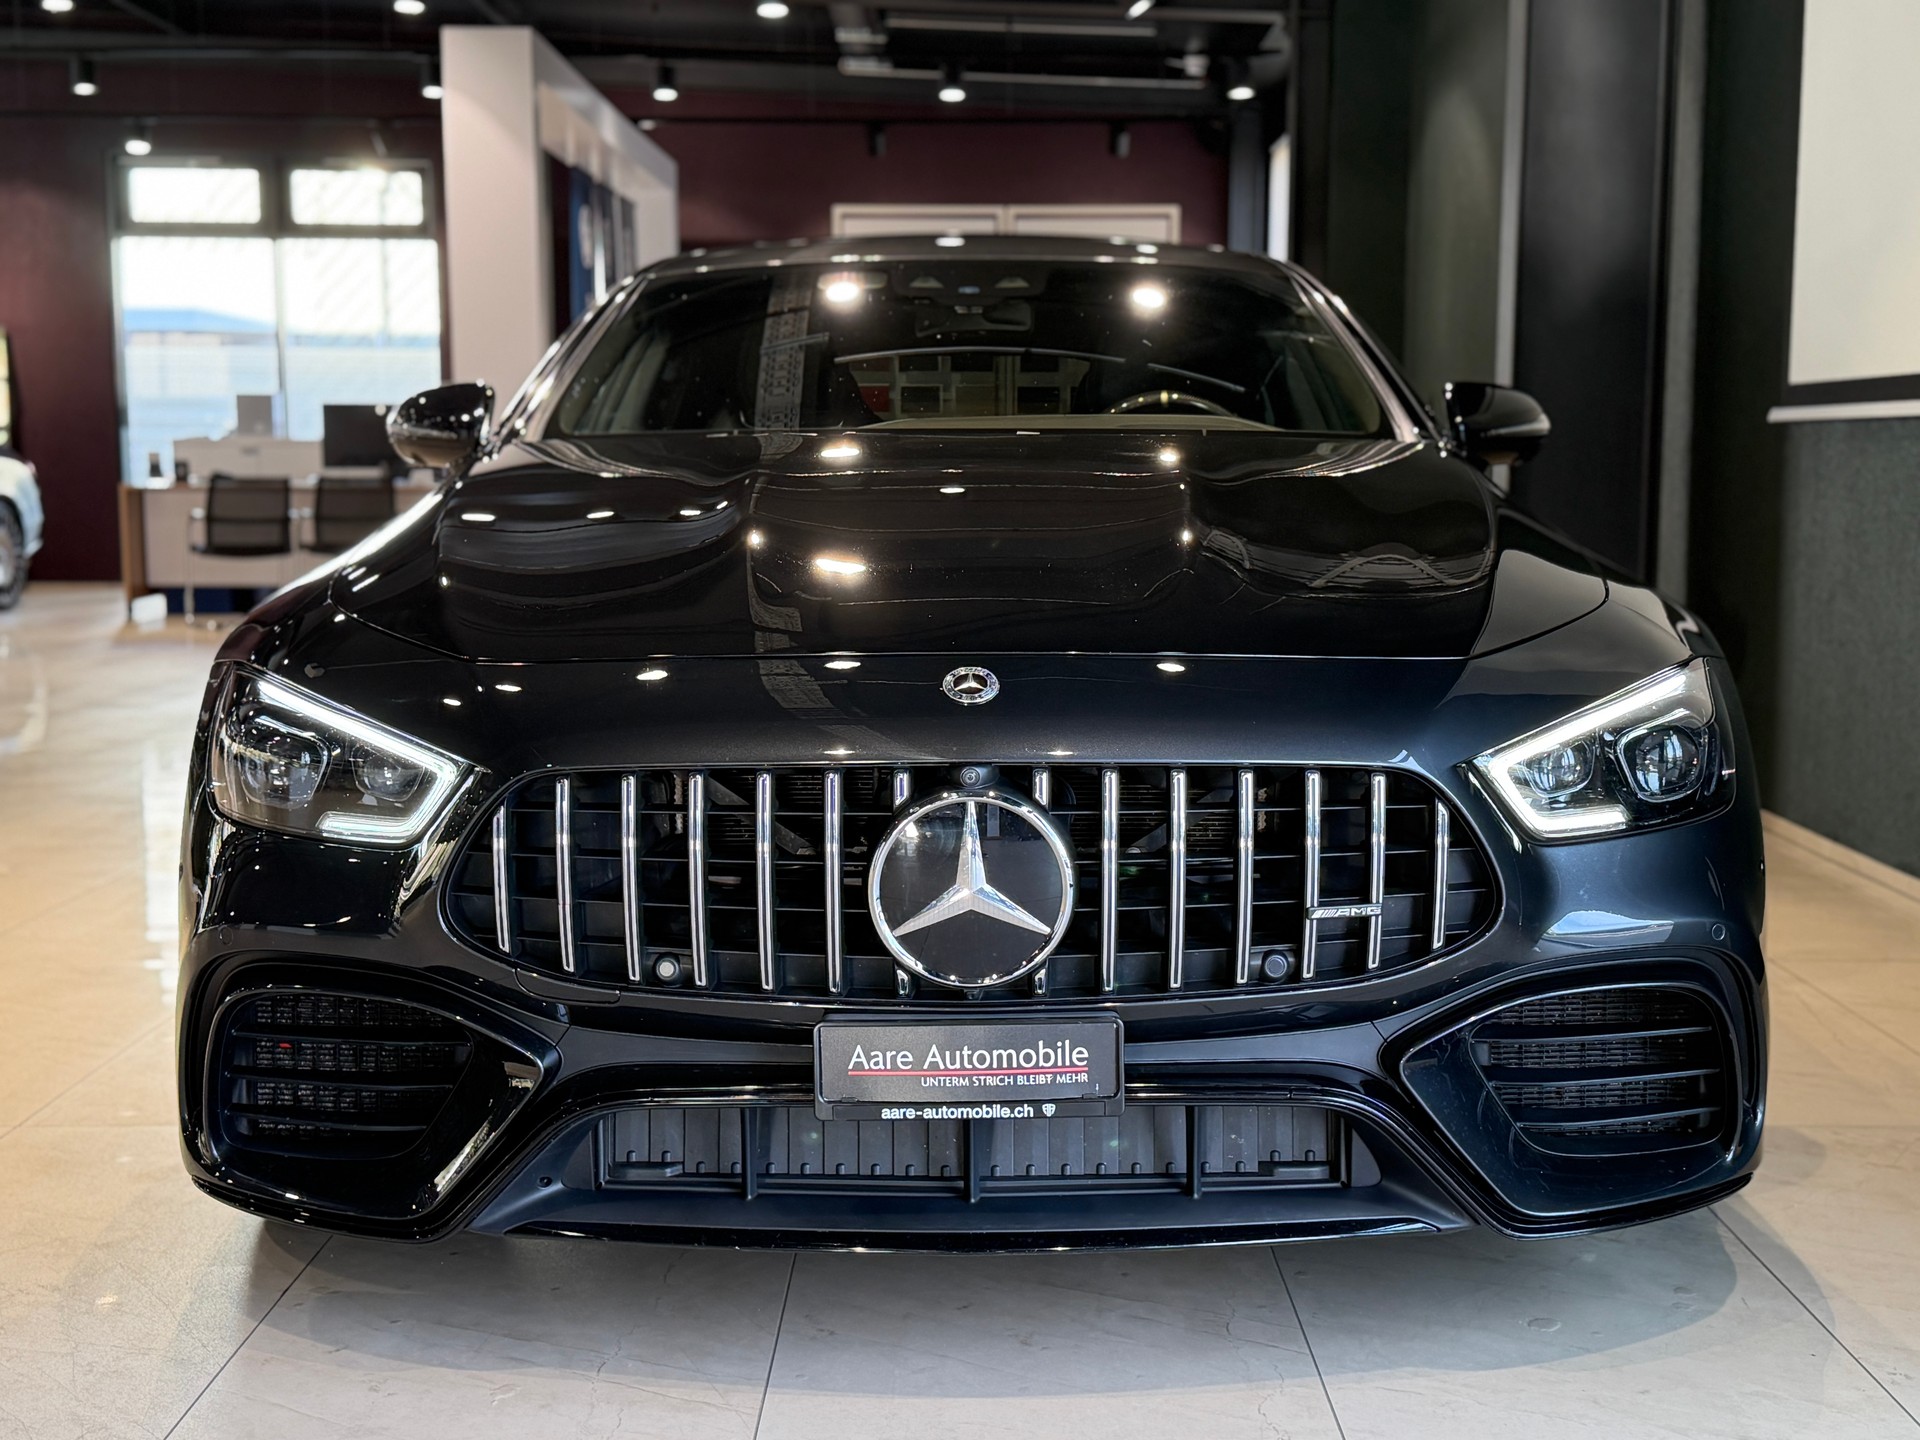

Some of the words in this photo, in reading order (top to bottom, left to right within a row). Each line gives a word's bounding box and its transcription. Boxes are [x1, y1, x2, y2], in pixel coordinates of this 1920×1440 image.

[1333, 907, 1382, 917] AMG
[848, 1044, 913, 1070] Aare
[923, 1040, 1089, 1069] Automobile
[921, 1076, 969, 1087] UNTERM
[973, 1075, 1013, 1086] STRICH
[1017, 1074, 1053, 1085] BLEIBT
[1056, 1073, 1088, 1084] MEHR
[881, 1103, 1034, 1119] aare-automobile.ch
